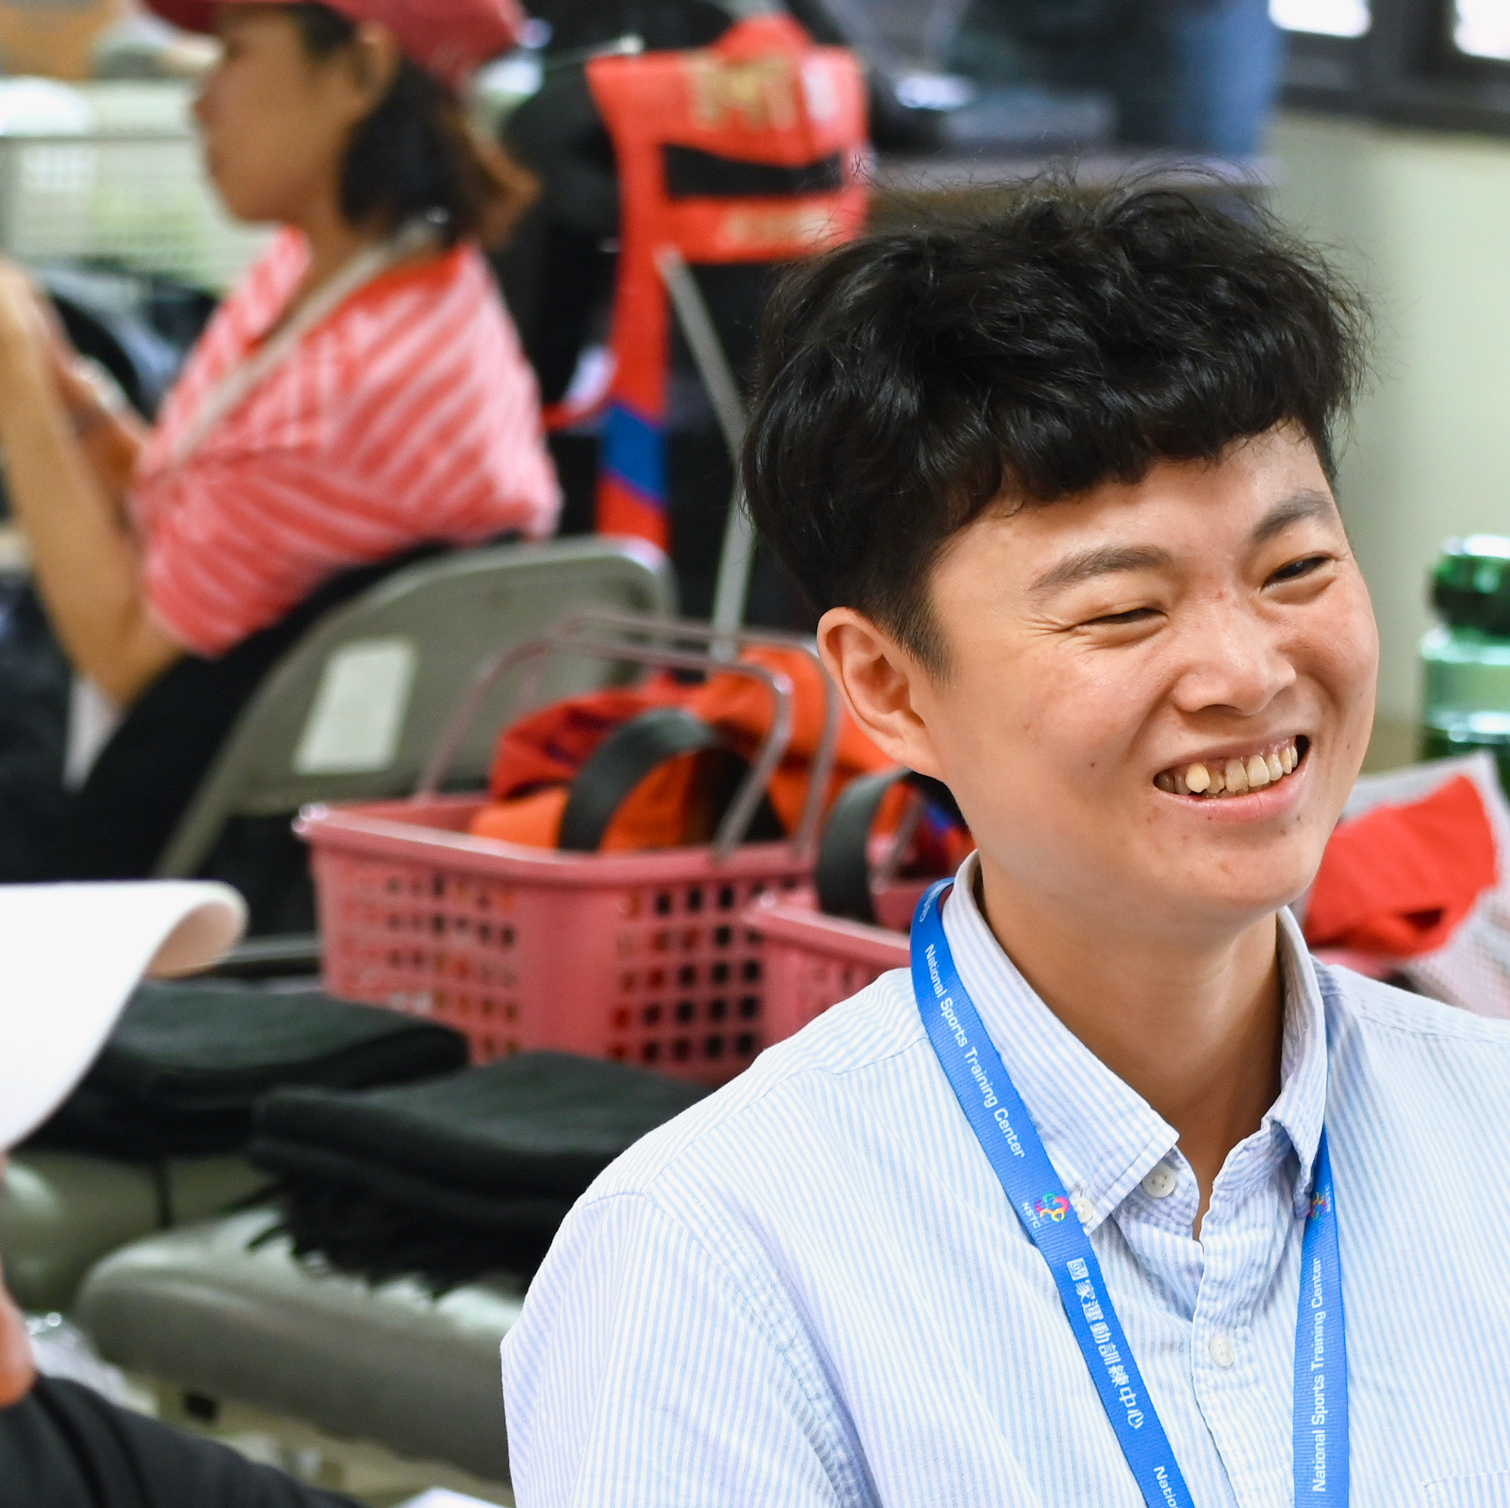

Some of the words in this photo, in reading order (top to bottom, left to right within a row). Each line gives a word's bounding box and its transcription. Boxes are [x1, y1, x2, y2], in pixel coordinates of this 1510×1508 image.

[925, 943, 947, 998] National
[940, 997, 968, 1048] Sports
[964, 1046, 999, 1108] Training
[993, 1107, 1026, 1159] Center
[1021, 1201, 1042, 1229] NSTC
[1311, 1257, 1322, 1309] Center
[1066, 1257, 1145, 1430] 國家運動訓練中心
[1310, 1311, 1326, 1372] Training
[1311, 1374, 1328, 1426] Sports
[1311, 1429, 1327, 1493] National
